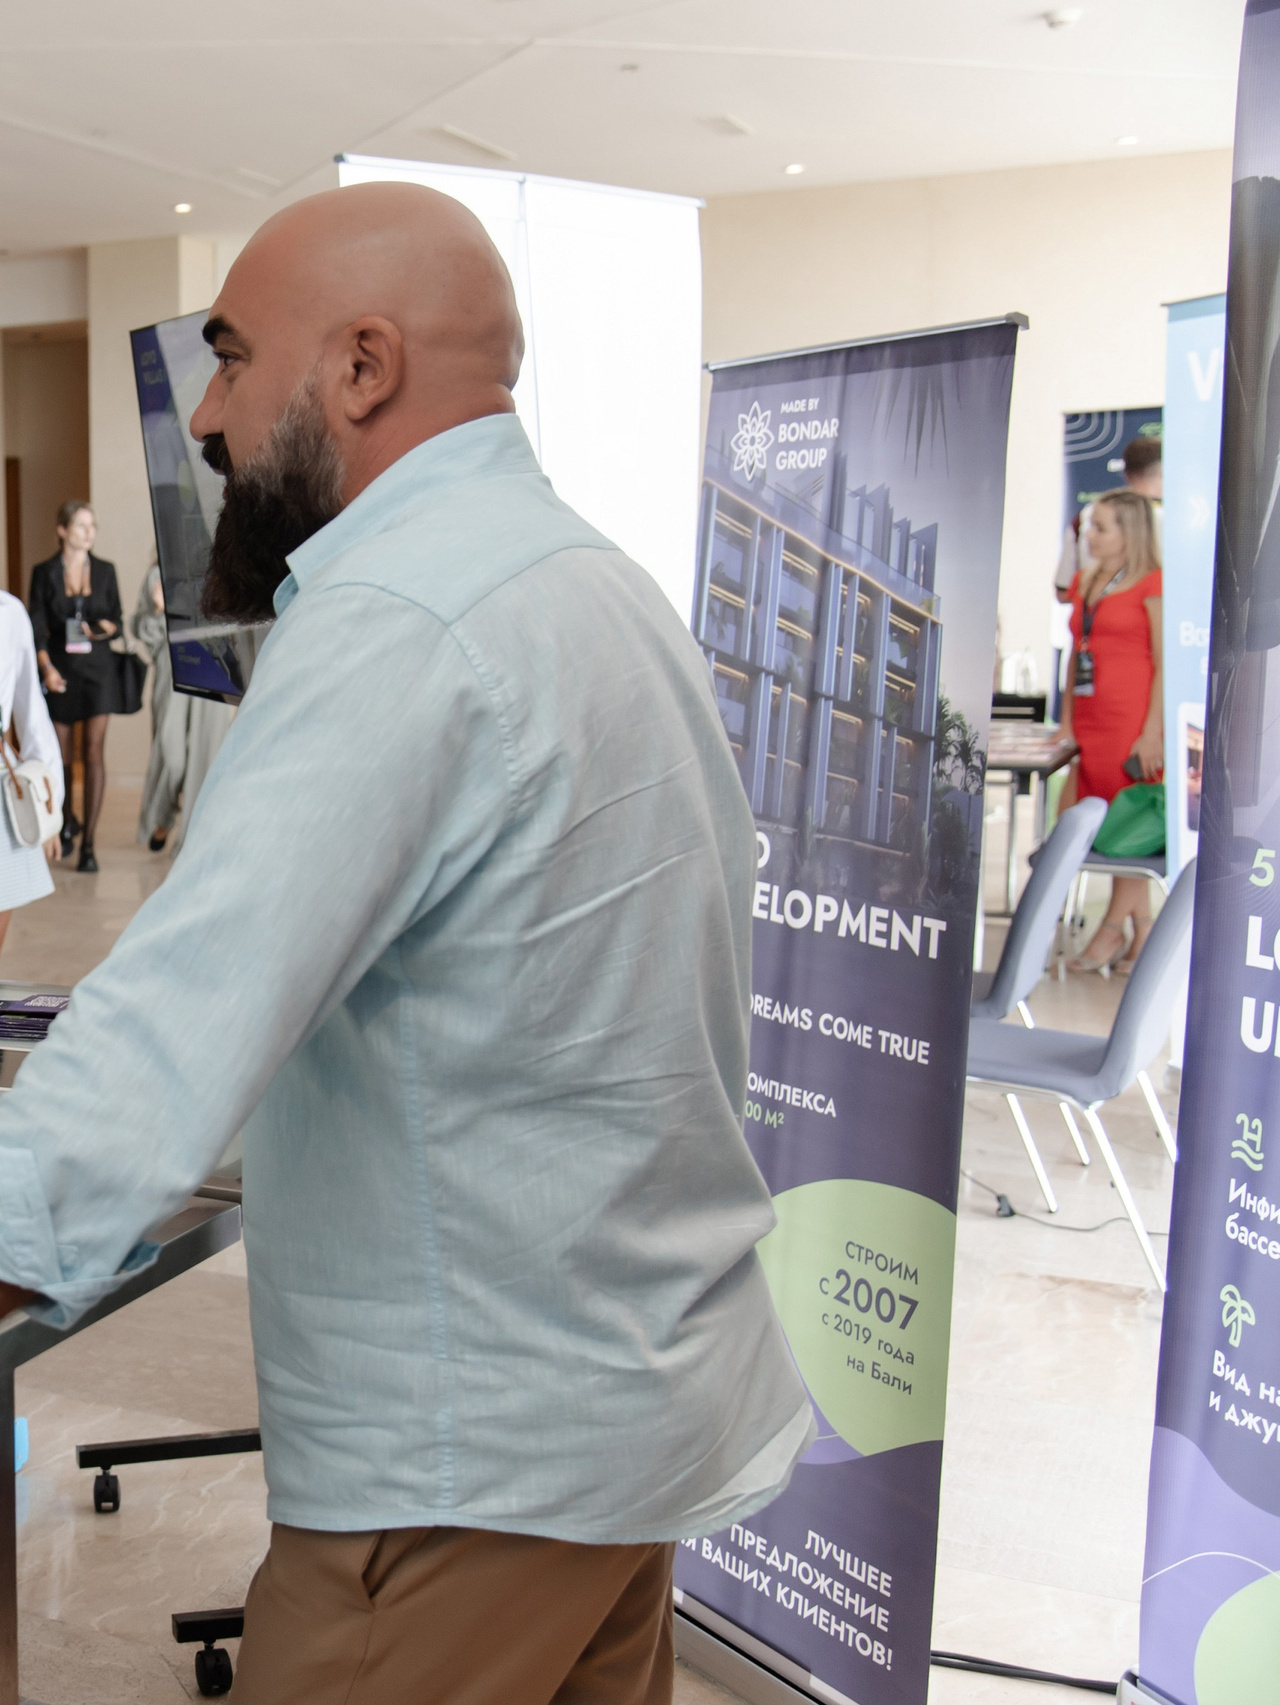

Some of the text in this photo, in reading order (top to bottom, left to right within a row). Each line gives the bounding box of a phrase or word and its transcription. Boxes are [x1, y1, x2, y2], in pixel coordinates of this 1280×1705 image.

[780, 397, 820, 414] MADE BY
[777, 418, 840, 443] BONDAR
[775, 447, 828, 471] GROUP
[752, 881, 948, 960] ELOPMENT
[1245, 915, 1280, 974] L
[818, 1012, 873, 1049] COME
[878, 1029, 930, 1066] TRUE
[747, 1071, 837, 1118] ОМПЛЕКСА
[1225, 1213, 1280, 1261] бассе
[845, 1241, 919, 1285] СТРОИМ
[833, 1268, 919, 1331] 2007
[834, 1313, 872, 1345] 2019
[877, 1338, 915, 1366] года
[846, 1354, 912, 1396] на Бали
[1212, 1349, 1251, 1397] Вид
[1208, 1390, 1221, 1412] и
[730, 1523, 890, 1633] ПРЕДЛОЖЕНИЕ
[805, 1529, 892, 1598] ЛУЧШЕЕ
[701, 1537, 771, 1597] ВАШИХ
[776, 1582, 893, 1671] КЛИЕНТОВ!
